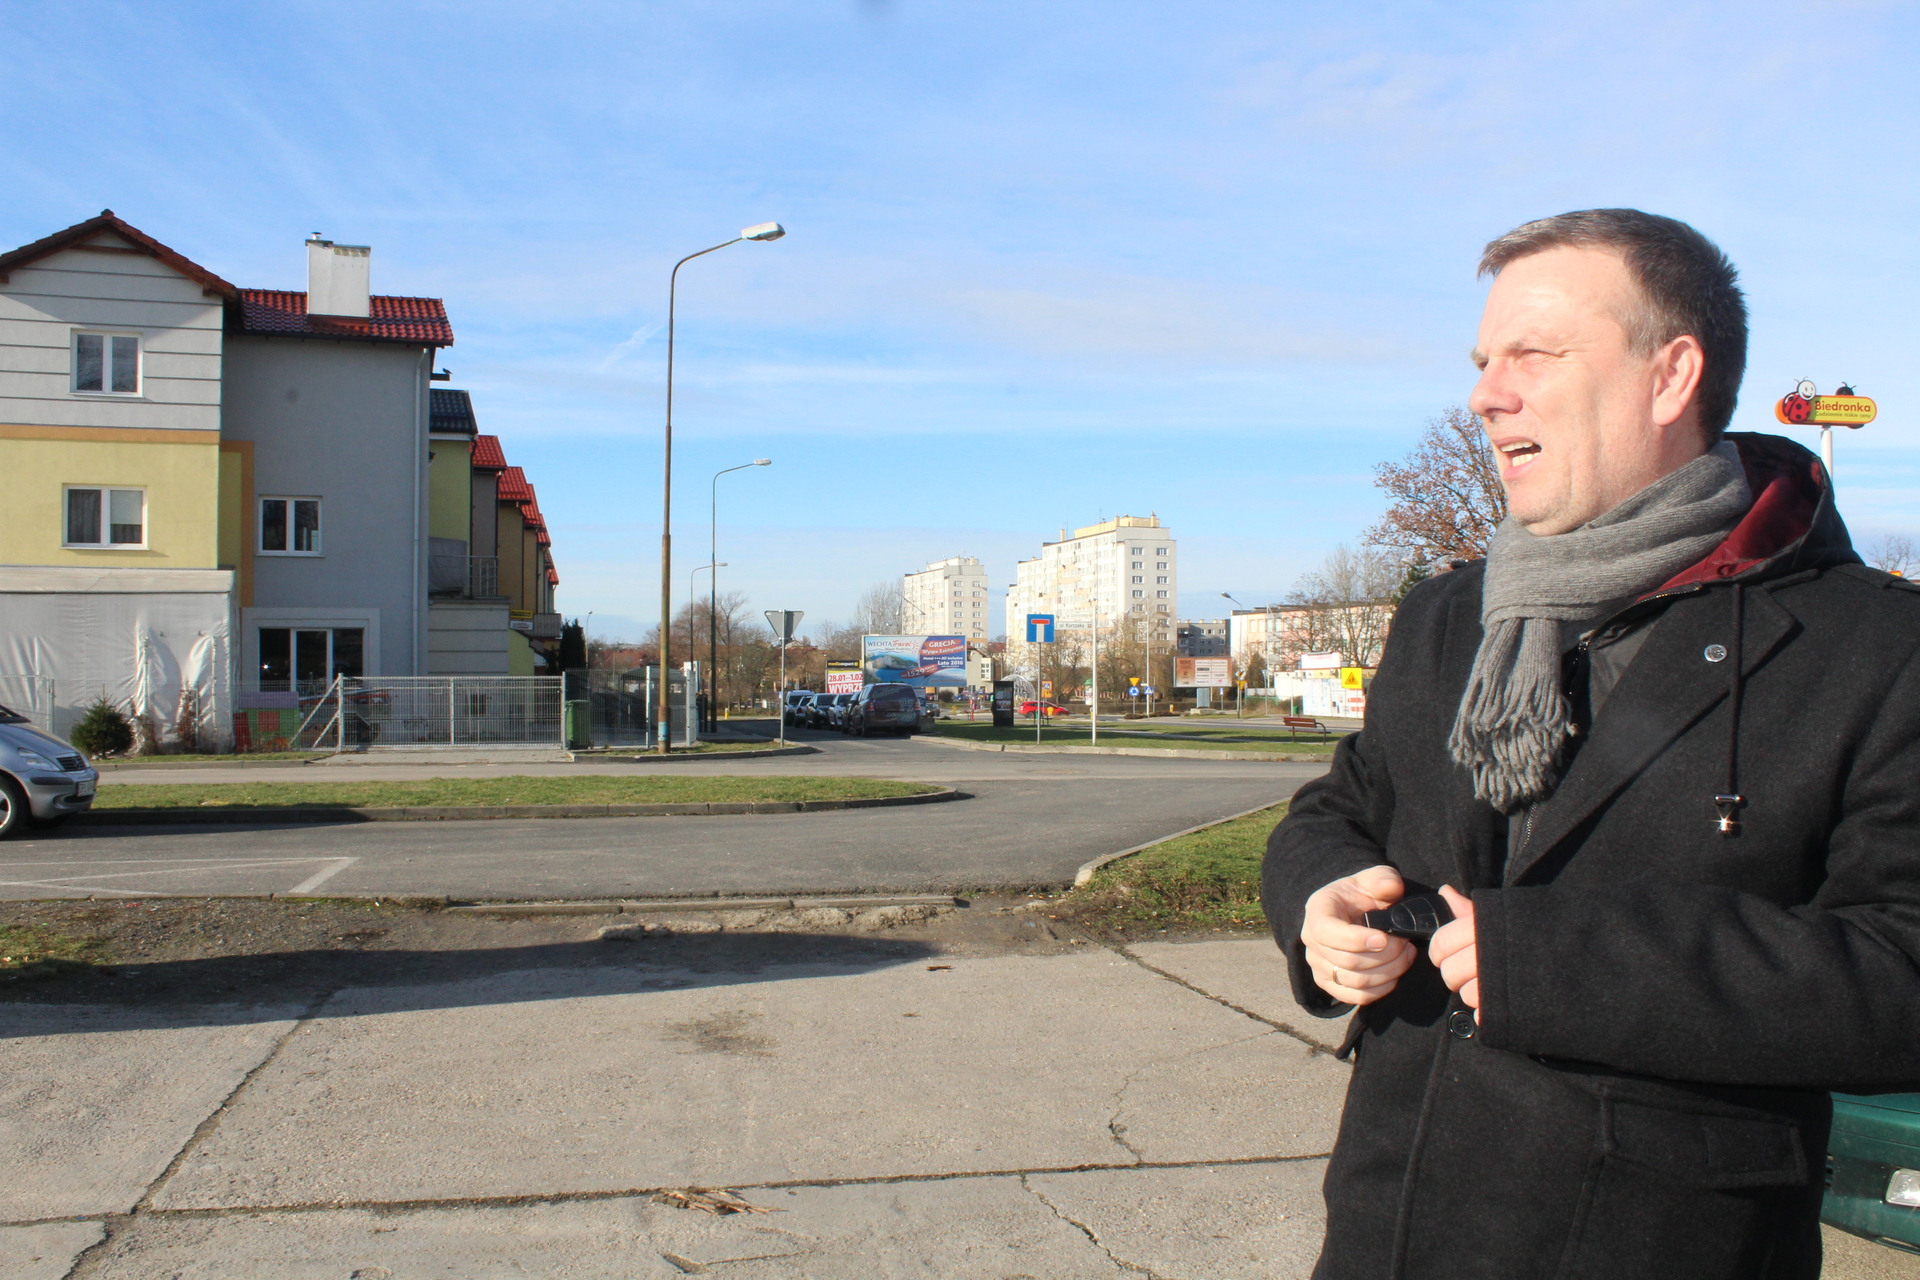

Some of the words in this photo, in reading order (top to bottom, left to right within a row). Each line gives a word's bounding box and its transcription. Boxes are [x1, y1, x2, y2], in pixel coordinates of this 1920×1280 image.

[1815, 400, 1871, 412] Biedronka
[892, 639, 912, 647] Travel
[928, 639, 956, 648] GRECJA
[907, 668, 925, 677] 1529
